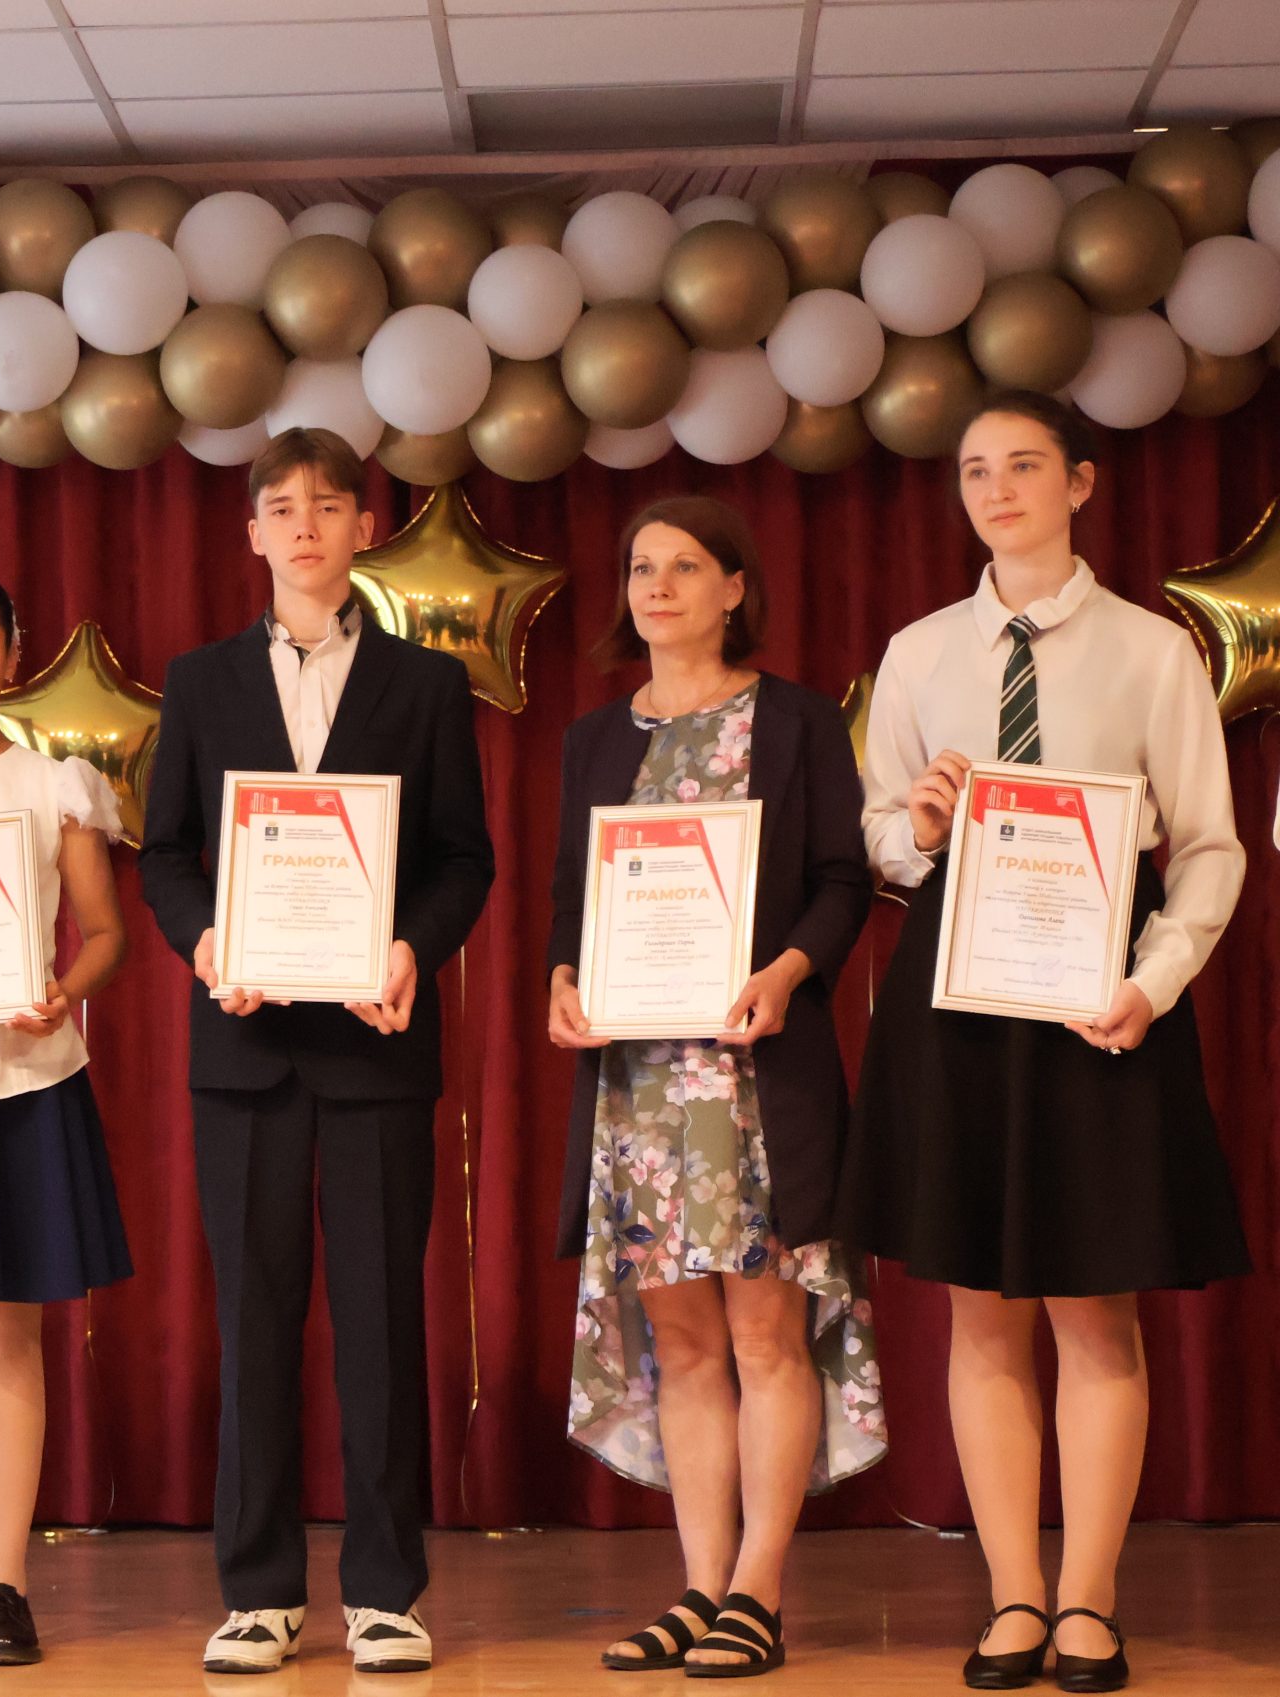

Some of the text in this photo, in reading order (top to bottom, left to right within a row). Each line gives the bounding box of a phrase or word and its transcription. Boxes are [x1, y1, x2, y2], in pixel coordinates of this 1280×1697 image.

[263, 855, 349, 868] ГРАМОТА
[996, 856, 1086, 877] ГРАМОТА
[626, 888, 709, 902] ГРАМОТА
